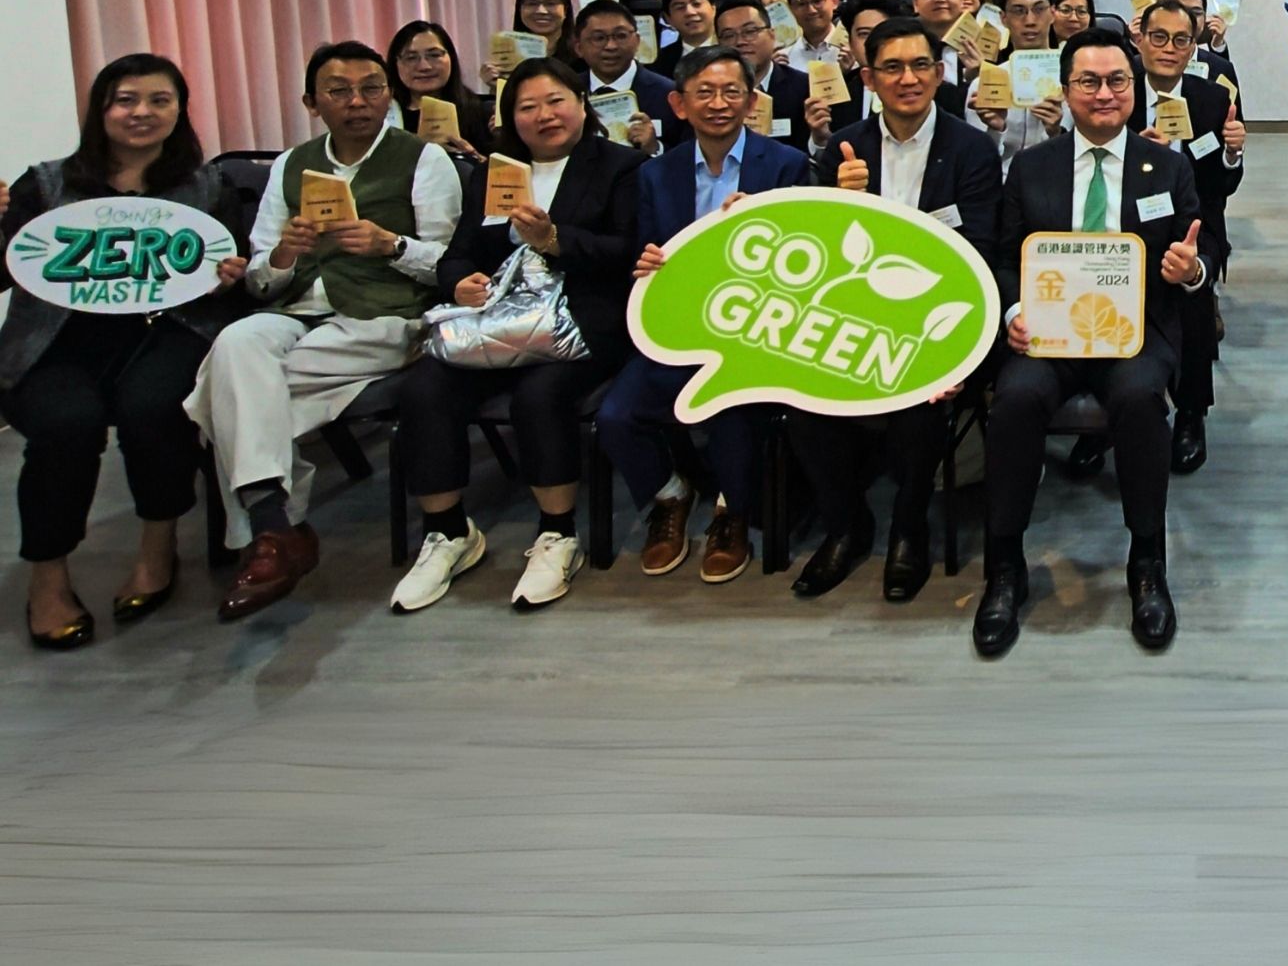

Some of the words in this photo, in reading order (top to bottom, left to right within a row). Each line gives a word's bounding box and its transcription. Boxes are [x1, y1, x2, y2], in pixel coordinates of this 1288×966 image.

[42, 226, 205, 282] ZERO
[732, 224, 822, 285] GO
[69, 280, 166, 305] WASTE
[1036, 270, 1066, 301] 金
[1097, 275, 1129, 285] 2024
[708, 284, 916, 386] GREEN
